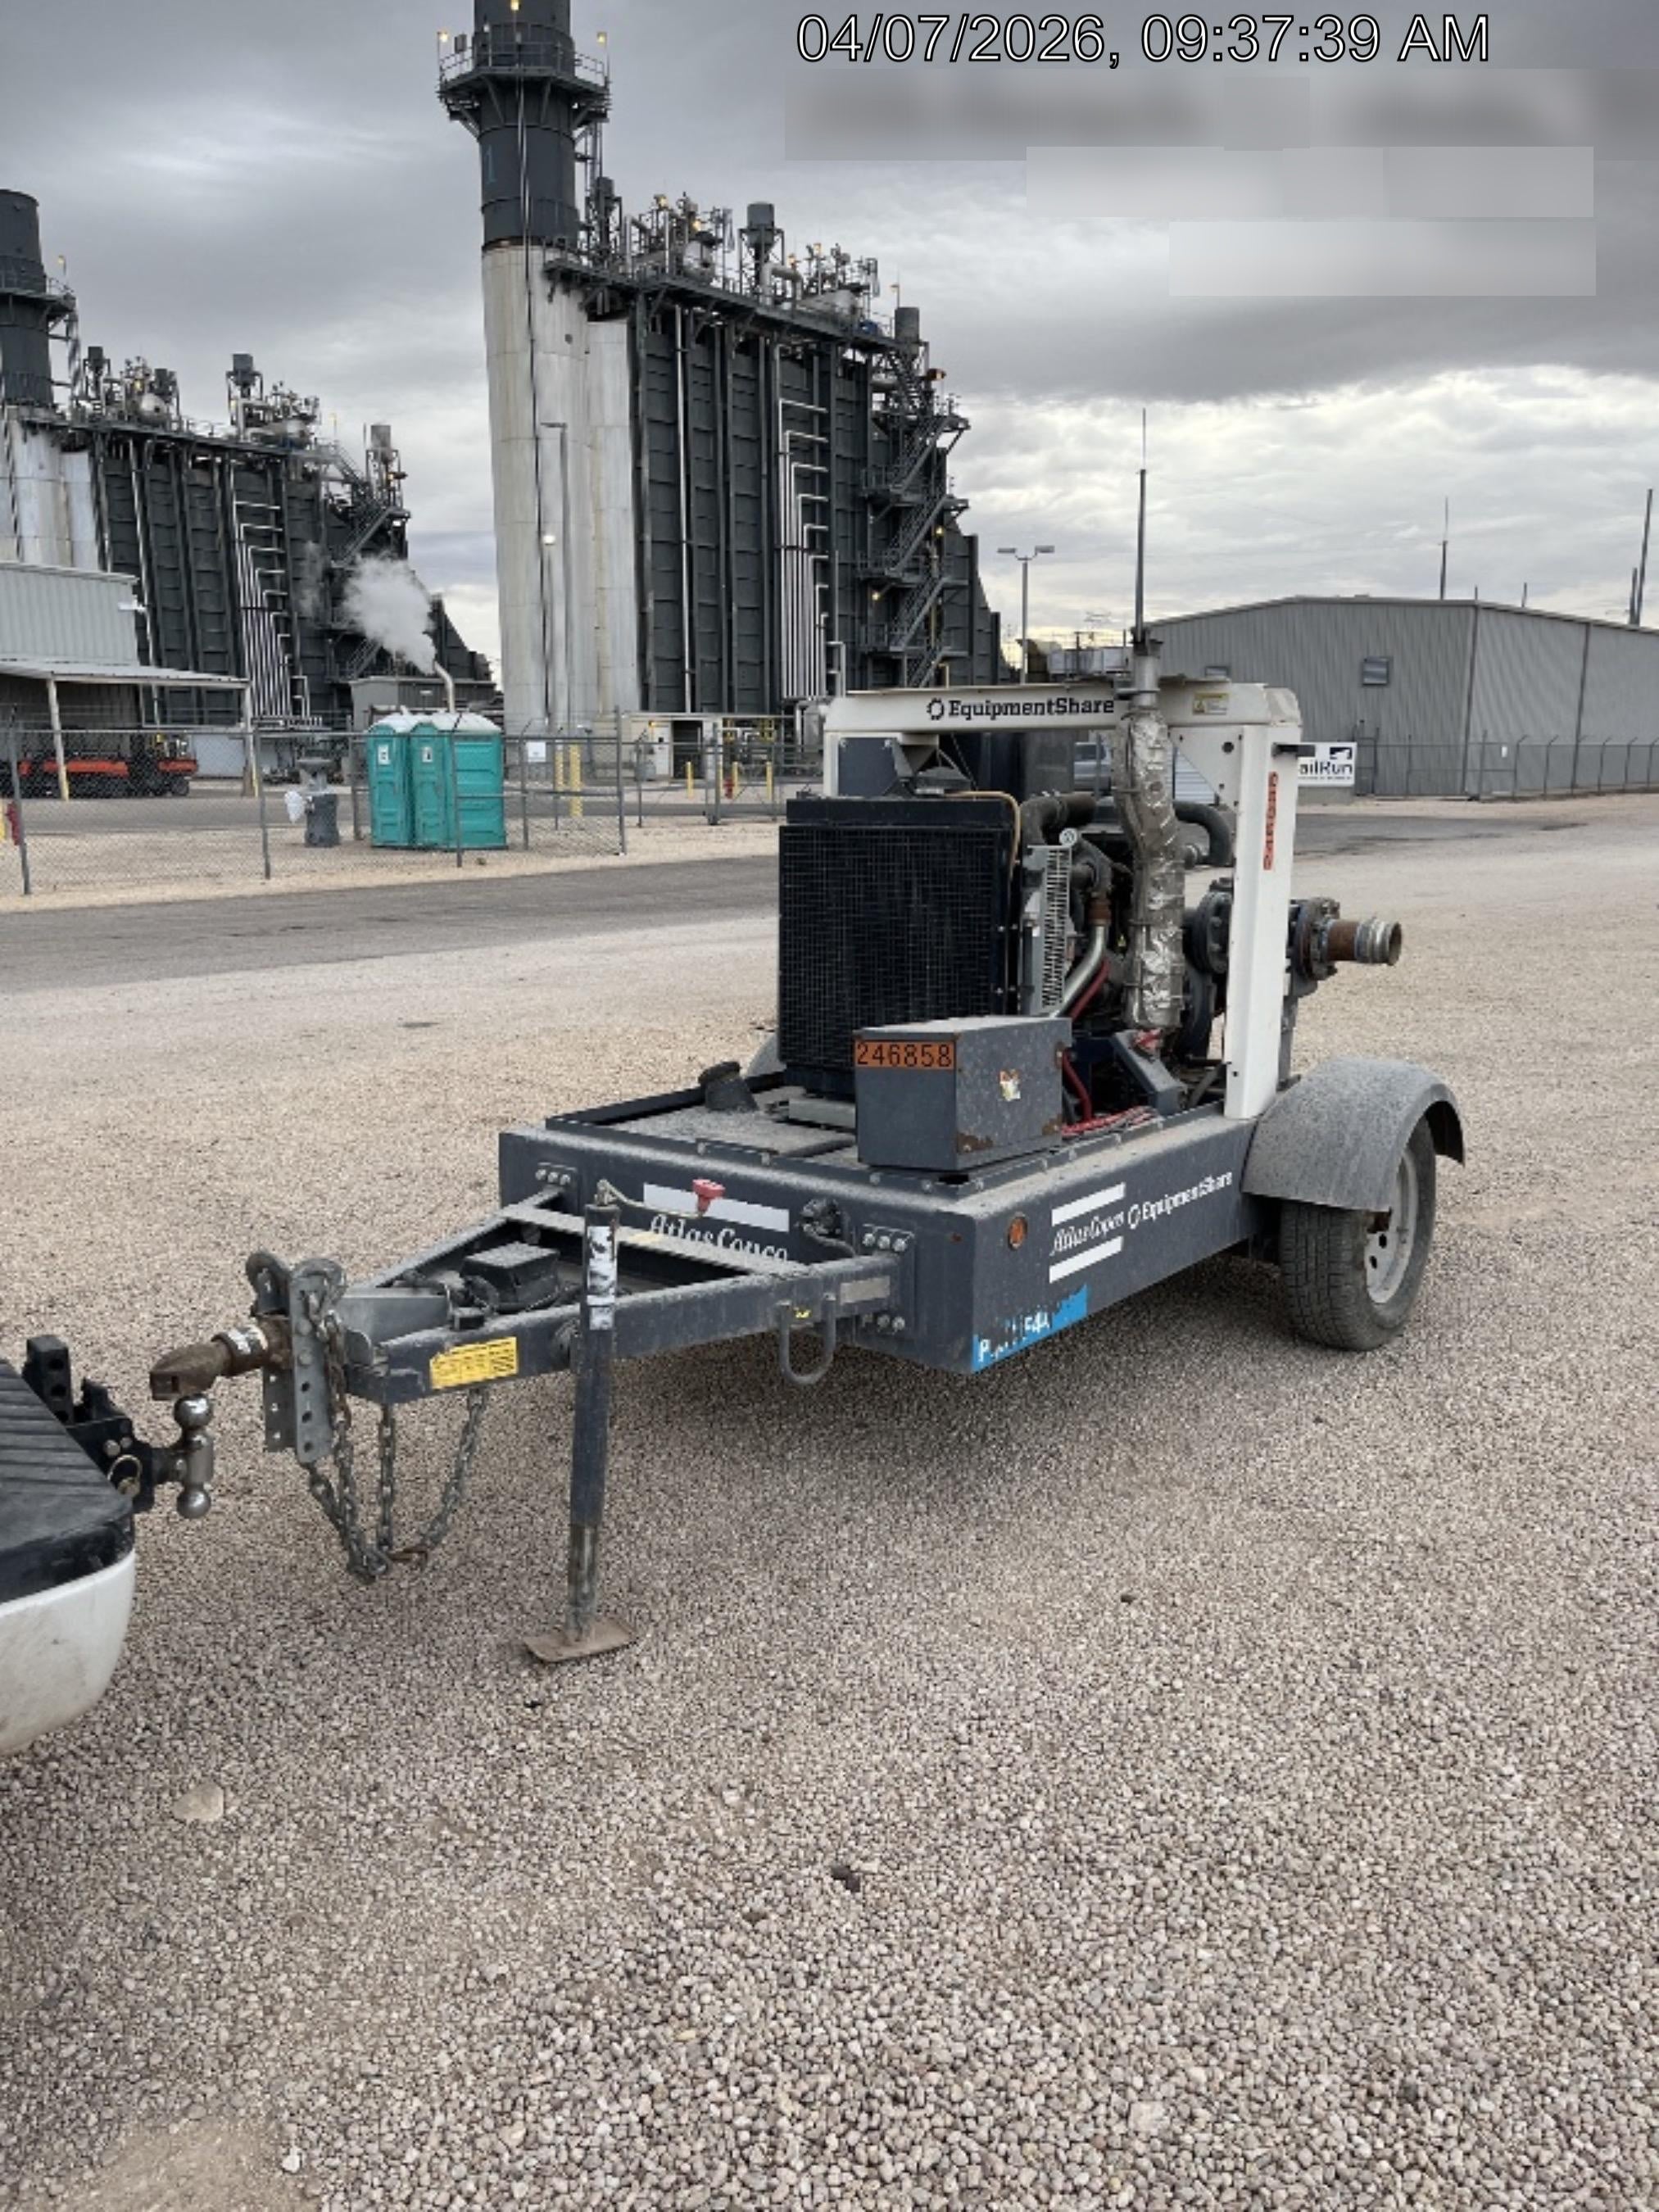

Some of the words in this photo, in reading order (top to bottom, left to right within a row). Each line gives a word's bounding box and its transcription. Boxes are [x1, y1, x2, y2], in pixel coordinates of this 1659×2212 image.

[948, 698, 1115, 720] EquipmentShare
[1299, 759, 1353, 775] ailRun
[857, 1042, 952, 1067] 246858
[1142, 1172, 1233, 1221] EquipmentShare
